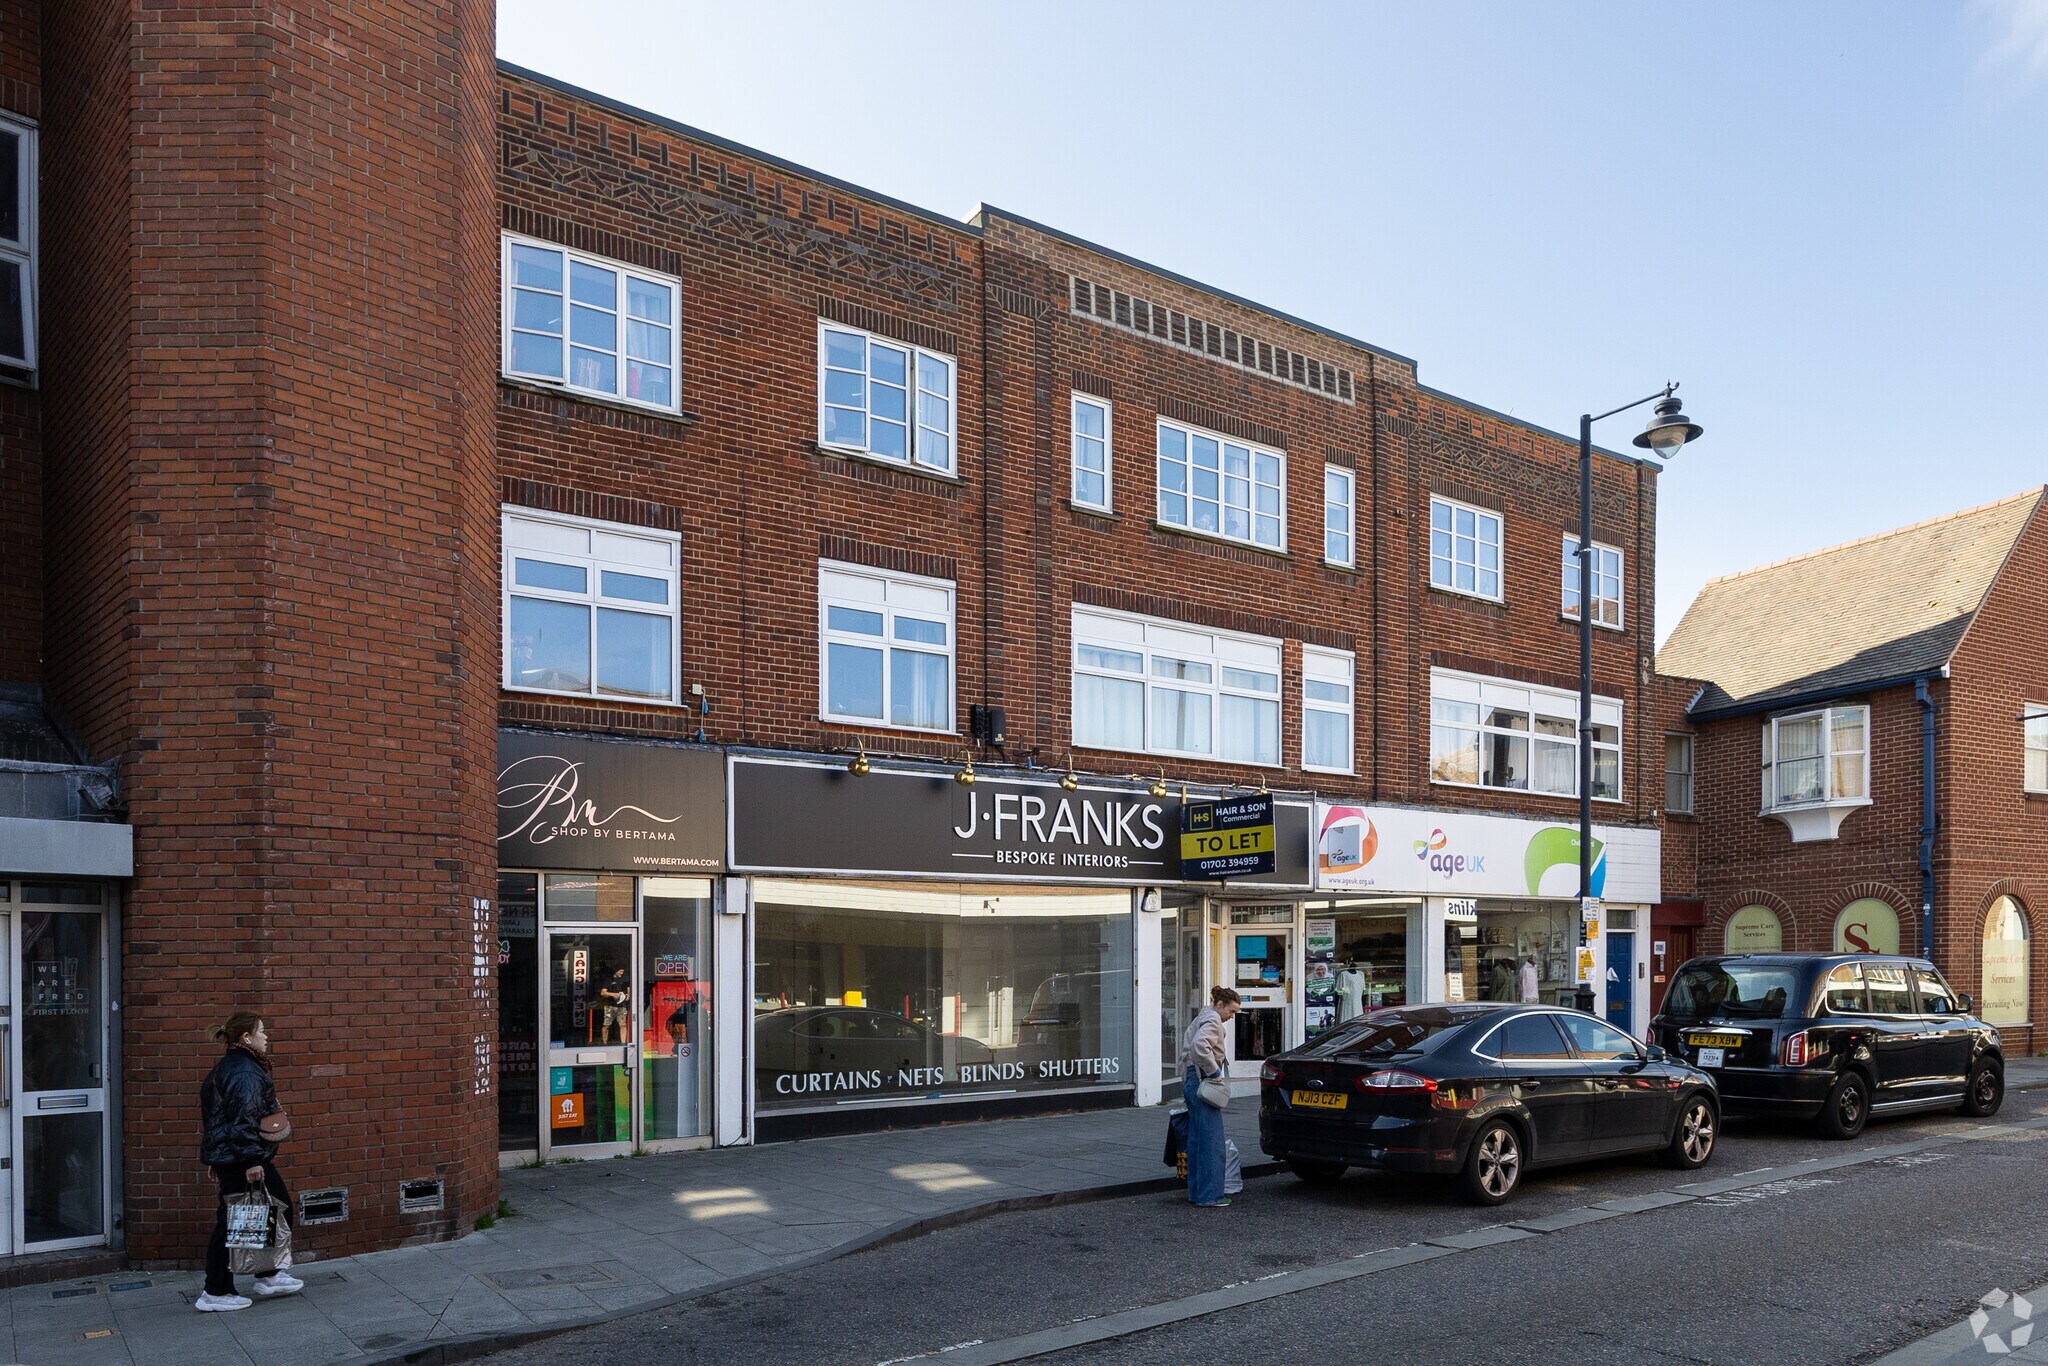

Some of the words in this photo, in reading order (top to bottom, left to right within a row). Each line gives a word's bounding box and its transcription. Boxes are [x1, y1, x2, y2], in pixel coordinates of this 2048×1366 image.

[1216, 807, 1238, 816] HAIR
[1239, 805, 1246, 813] &
[1247, 802, 1266, 812] SON
[1223, 812, 1260, 823] Commercial
[551, 826, 588, 837] SHOP
[594, 829, 610, 838] BY
[616, 830, 676, 841] BERTAMA
[1196, 836, 1223, 853] TO
[1229, 832, 1262, 850] LET
[633, 856, 719, 867] WWW.BERTAMA.COM
[996, 850, 1055, 865] BESPOKE
[1063, 853, 1129, 868] INTERIORS
[1200, 859, 1227, 869] 01702
[1229, 856, 1259, 867] 394959
[1328, 878, 1375, 886] www.ageuk.org.uk
[1983, 954, 2009, 966] Supreme
[2010, 953, 2025, 964] Care
[657, 962, 691, 974] OPEN
[1990, 973, 2016, 984] Services
[1983, 999, 2011, 1009] Recruiting
[2012, 999, 2025, 1008] Now
[1693, 1034, 1717, 1044] FE73
[1719, 1036, 1738, 1045] XBW
[776, 1069, 882, 1094] CURTAINS
[898, 1066, 944, 1088] NETS
[961, 1062, 1025, 1083] BLINDS
[1039, 1057, 1120, 1078] SHUTTERS
[1298, 1091, 1320, 1104] NJ13
[1321, 1093, 1342, 1106] CZF
